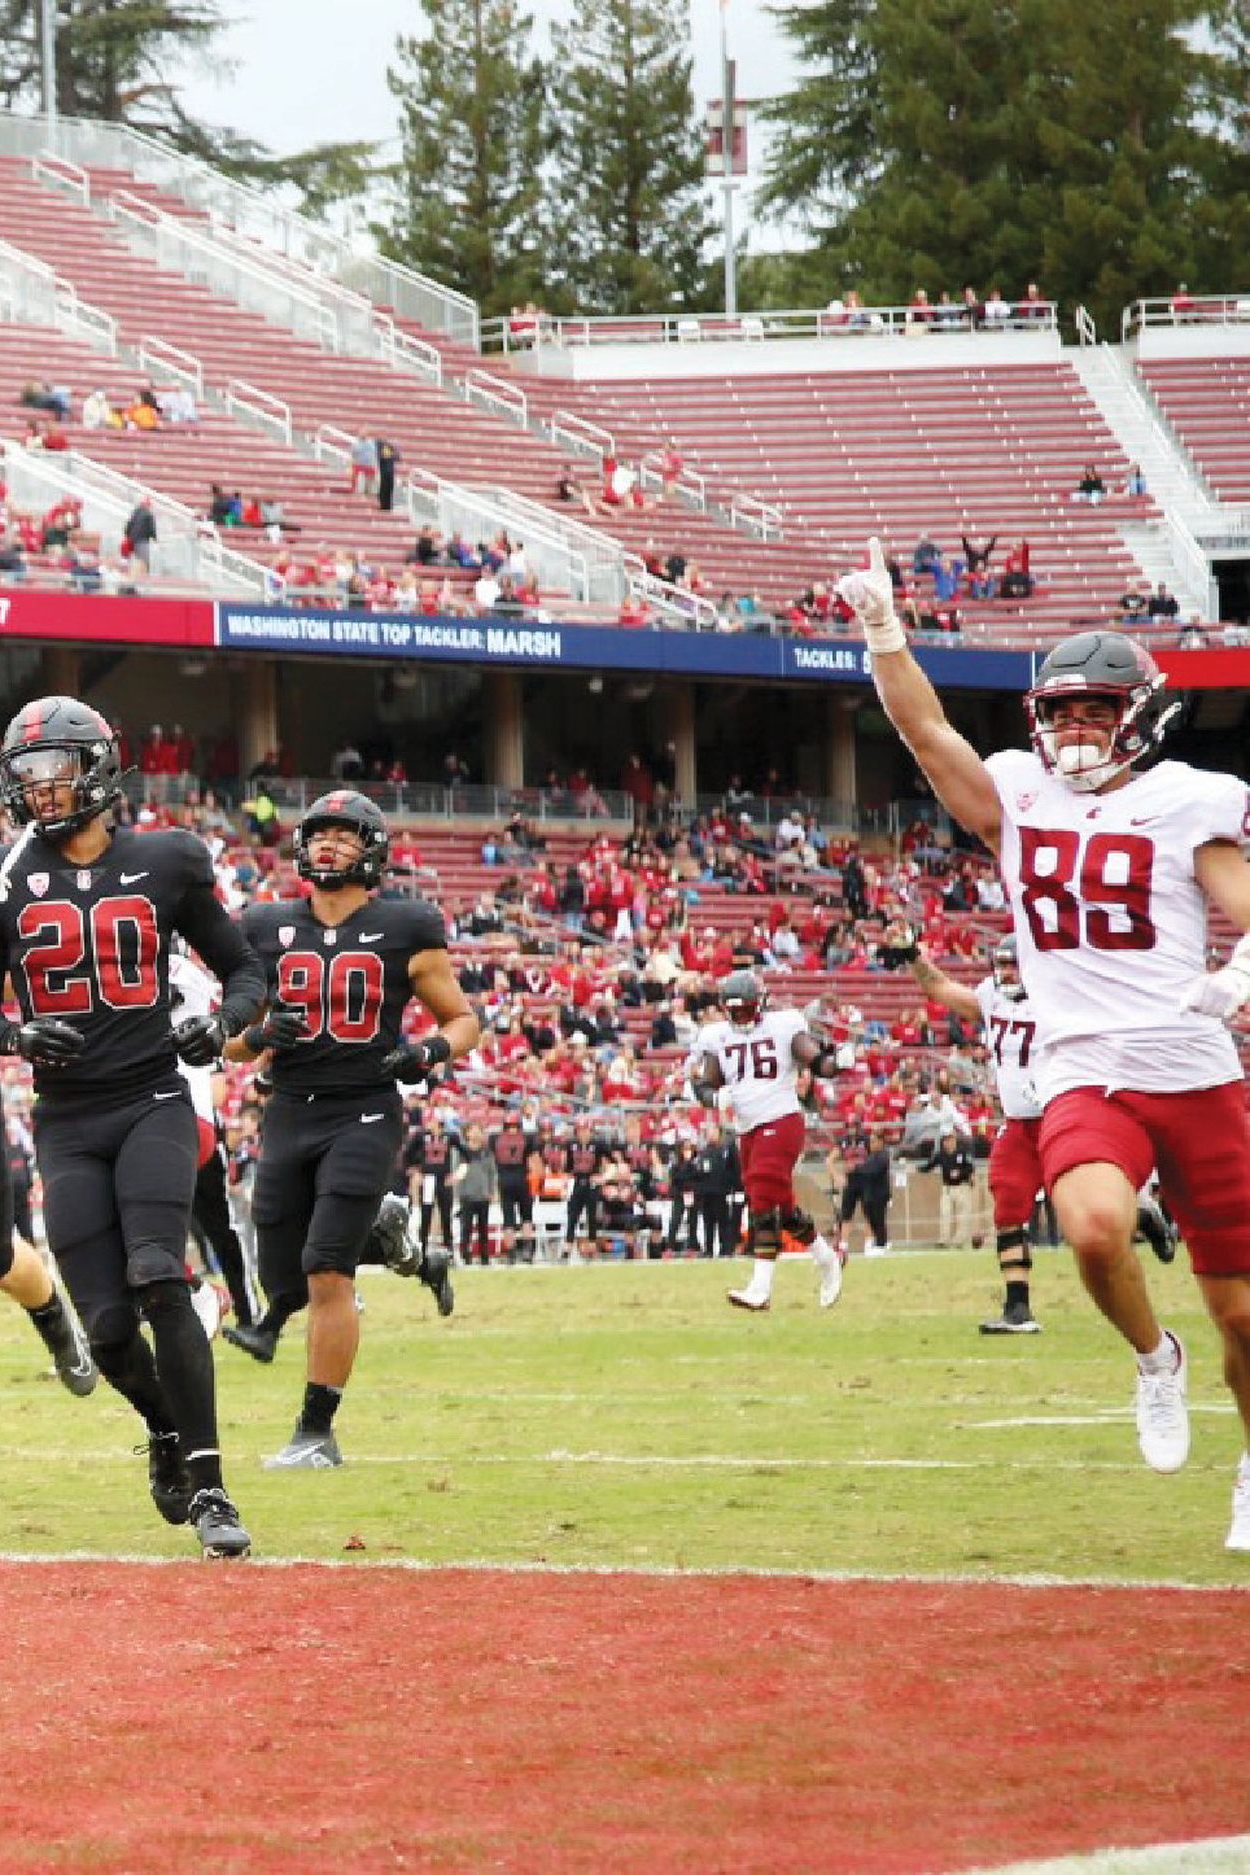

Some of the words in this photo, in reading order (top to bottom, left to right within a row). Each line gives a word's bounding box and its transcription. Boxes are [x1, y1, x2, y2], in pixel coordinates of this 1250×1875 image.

[227, 614, 330, 639] WASHINGTON
[332, 620, 380, 645] STATE
[381, 622, 411, 646] TOP
[415, 625, 485, 650] TACKLER:
[487, 628, 561, 658] MARSH
[794, 647, 856, 671] TACKLES:
[1018, 826, 1157, 952] 89
[17, 893, 160, 1015] 20
[277, 951, 385, 1043] 90
[724, 1036, 778, 1081] 76
[990, 1015, 1036, 1069] 77
